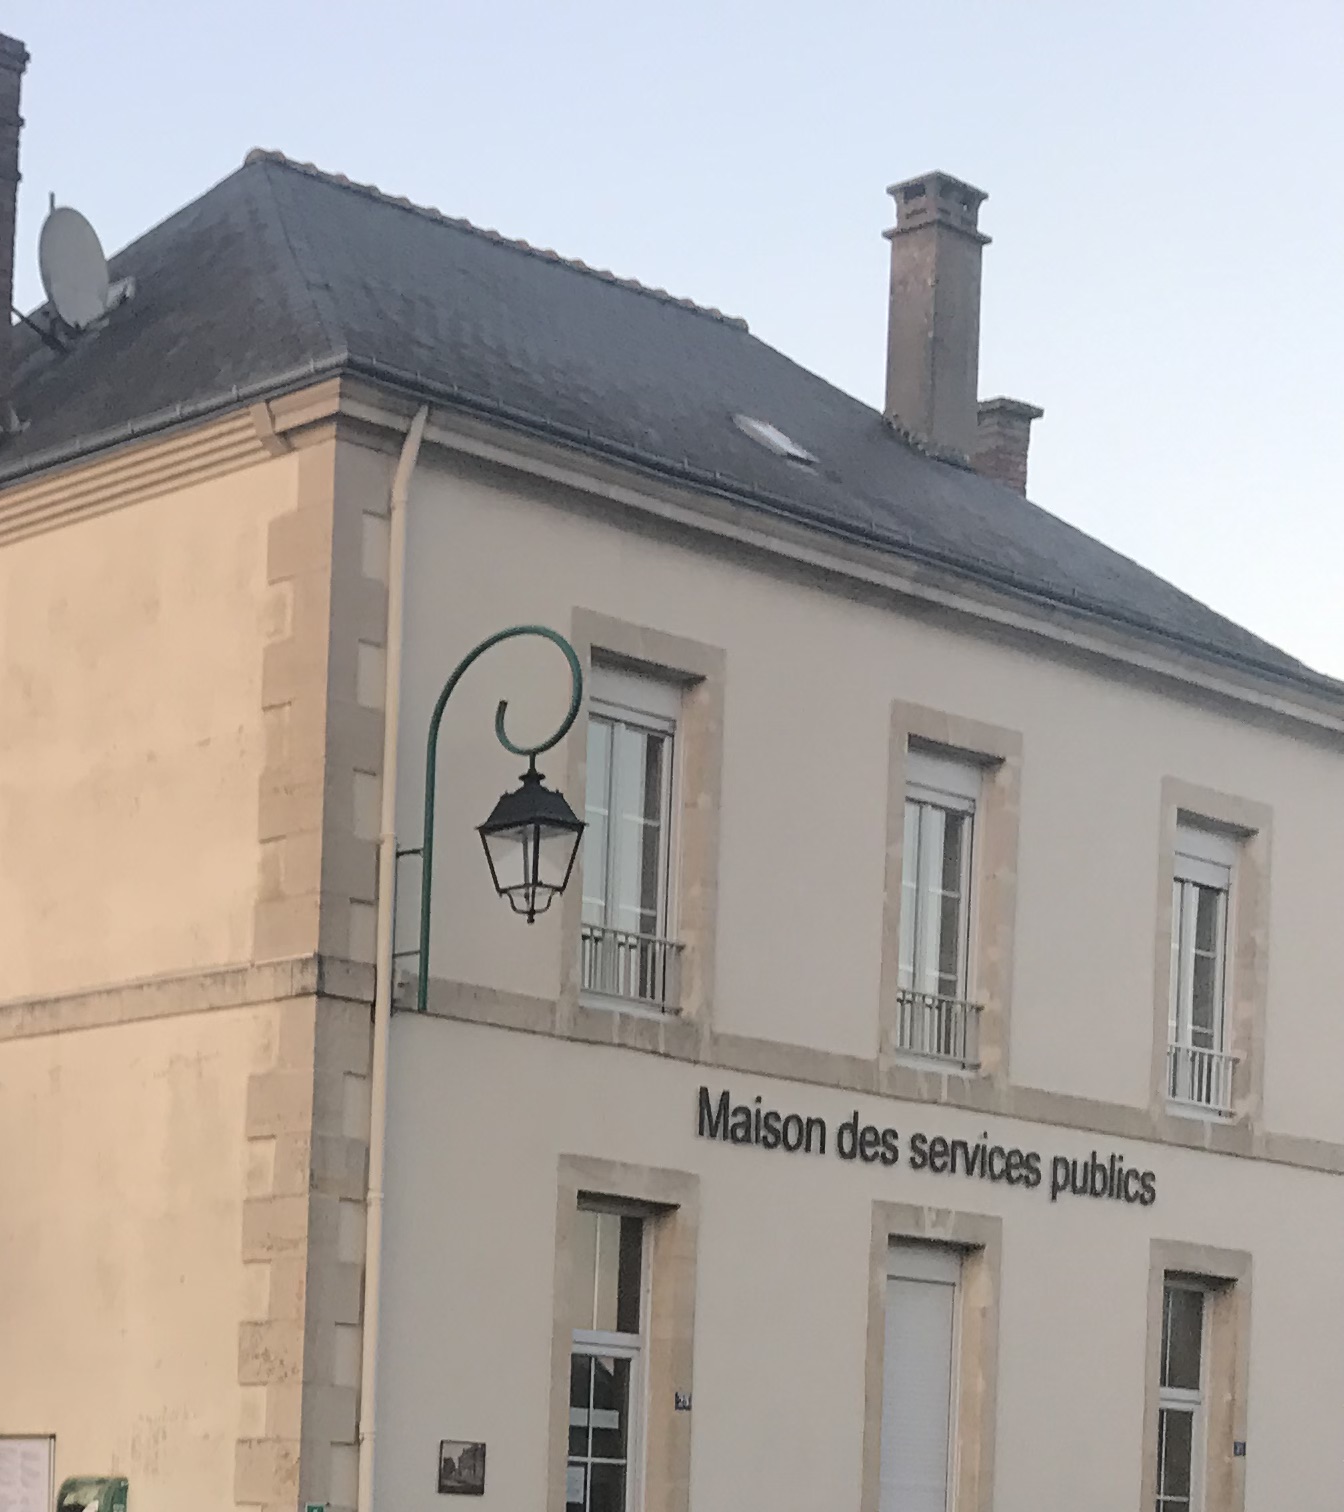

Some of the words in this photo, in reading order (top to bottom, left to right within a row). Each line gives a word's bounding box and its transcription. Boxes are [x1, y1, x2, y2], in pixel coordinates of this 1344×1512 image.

[698, 1086, 826, 1154] Maison
[838, 1111, 900, 1165] des
[910, 1131, 1042, 1188] services
[1051, 1151, 1157, 1206] publics
